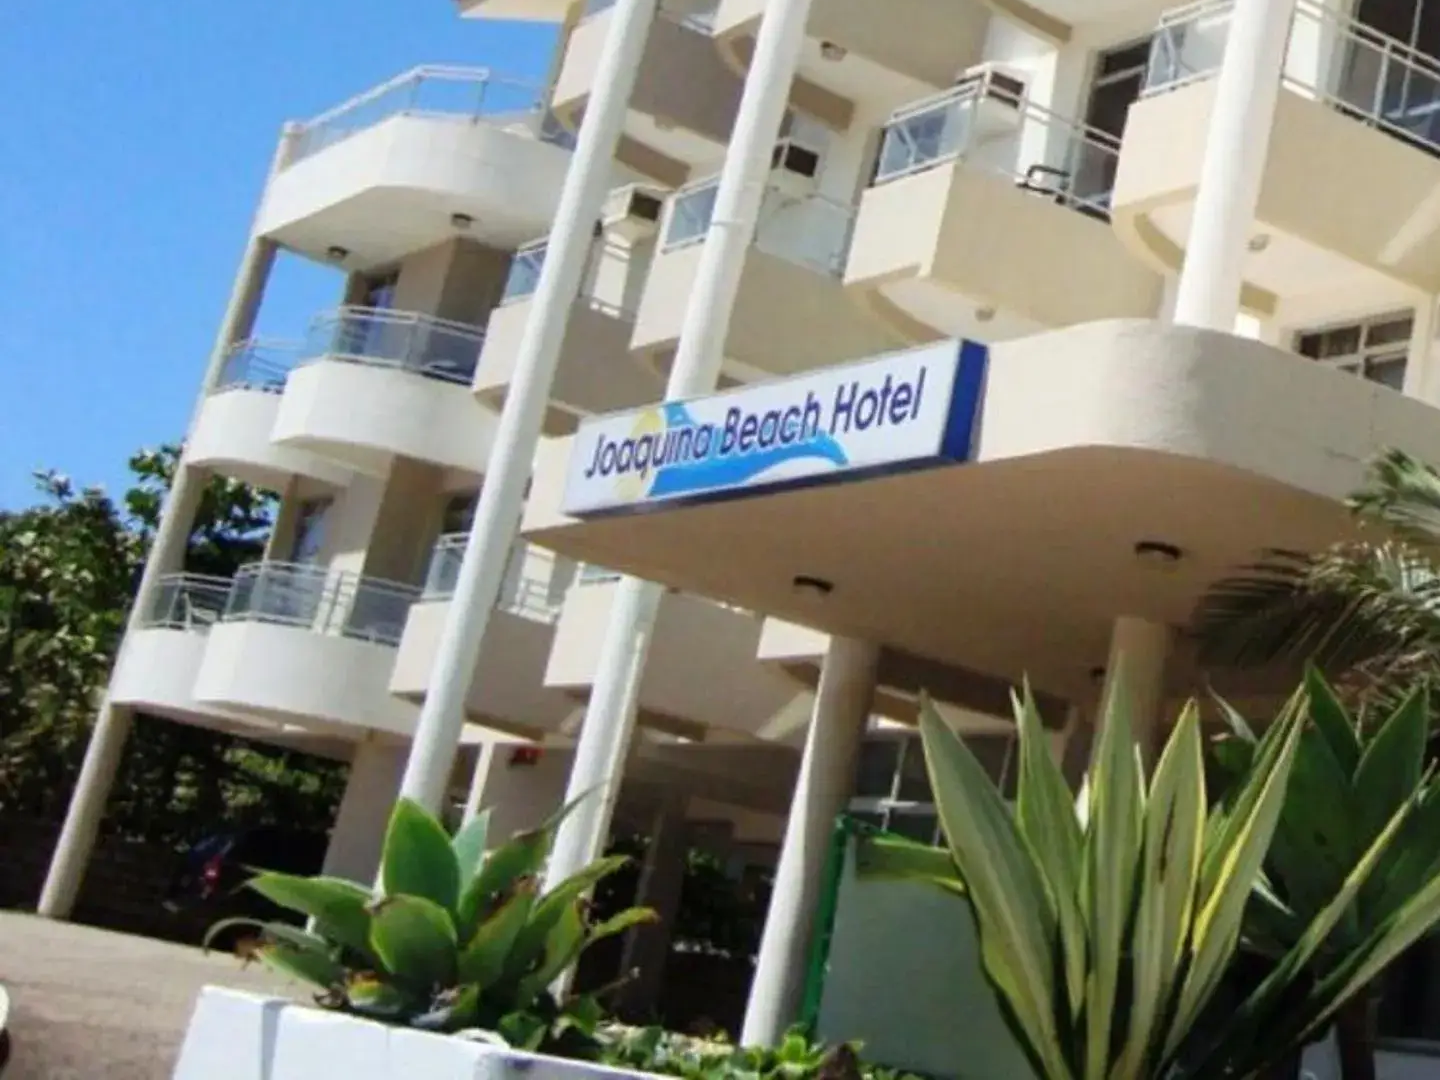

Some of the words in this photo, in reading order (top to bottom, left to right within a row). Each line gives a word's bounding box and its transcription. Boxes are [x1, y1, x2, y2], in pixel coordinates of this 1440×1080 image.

[585, 423, 714, 480] Joaquina
[720, 392, 821, 454] Beach
[829, 366, 928, 434] Hotel
